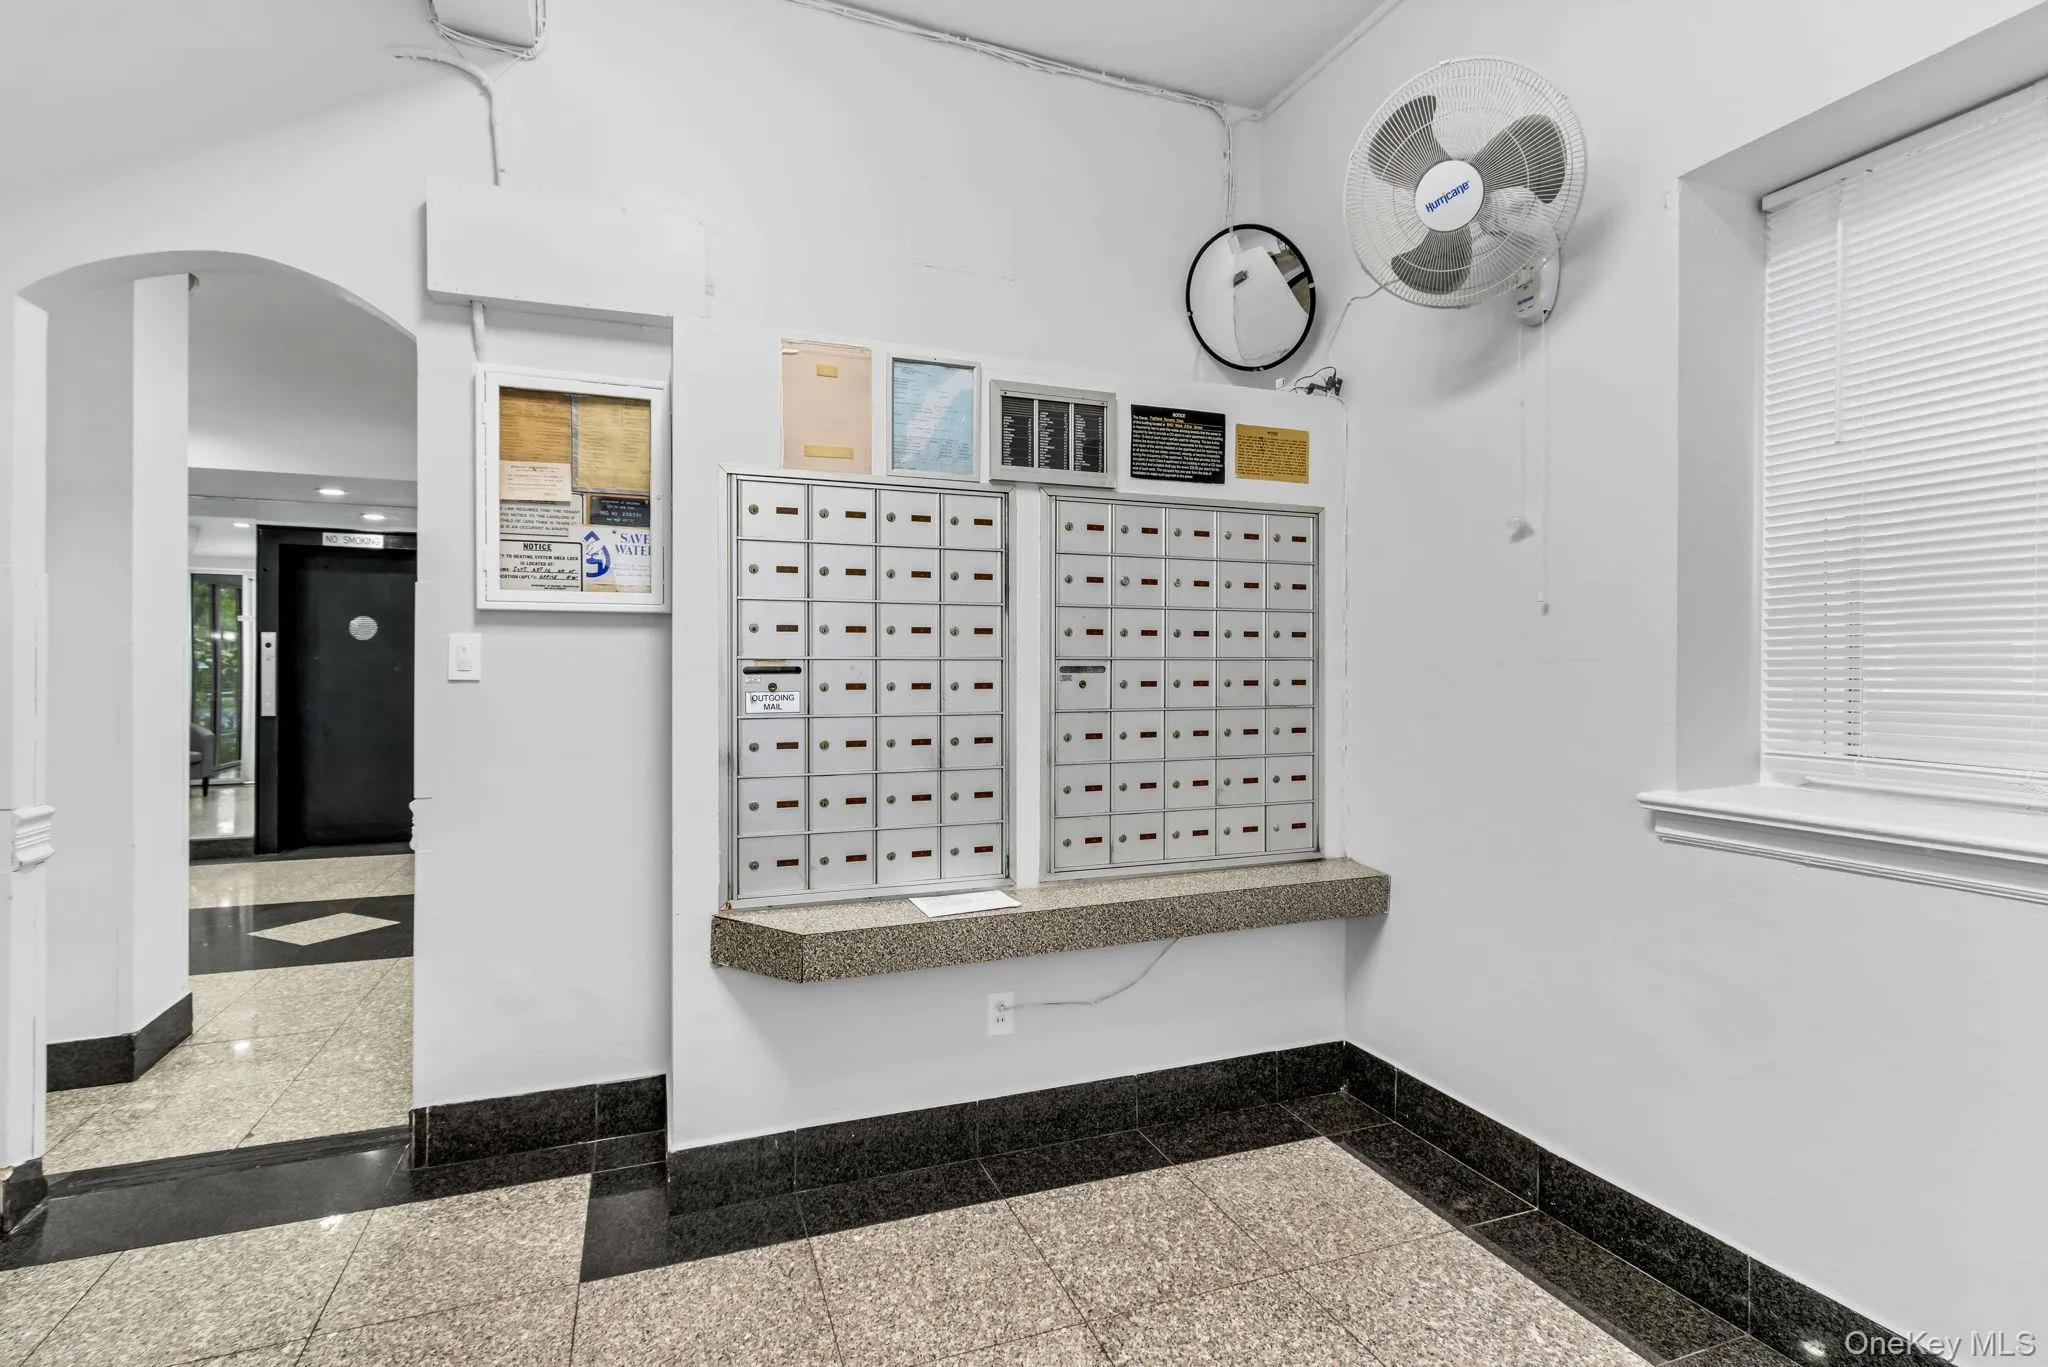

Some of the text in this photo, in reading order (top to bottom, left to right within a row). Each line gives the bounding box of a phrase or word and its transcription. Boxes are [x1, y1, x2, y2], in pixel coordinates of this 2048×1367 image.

[1425, 180, 1469, 213] Hurricane
[325, 535, 379, 546] NO SMOKING
[620, 533, 650, 544] SAVE
[523, 542, 552, 550] NOTICE
[614, 544, 651, 556] WATE
[751, 694, 795, 702] OUTGOING
[763, 703, 783, 711] MAIL
